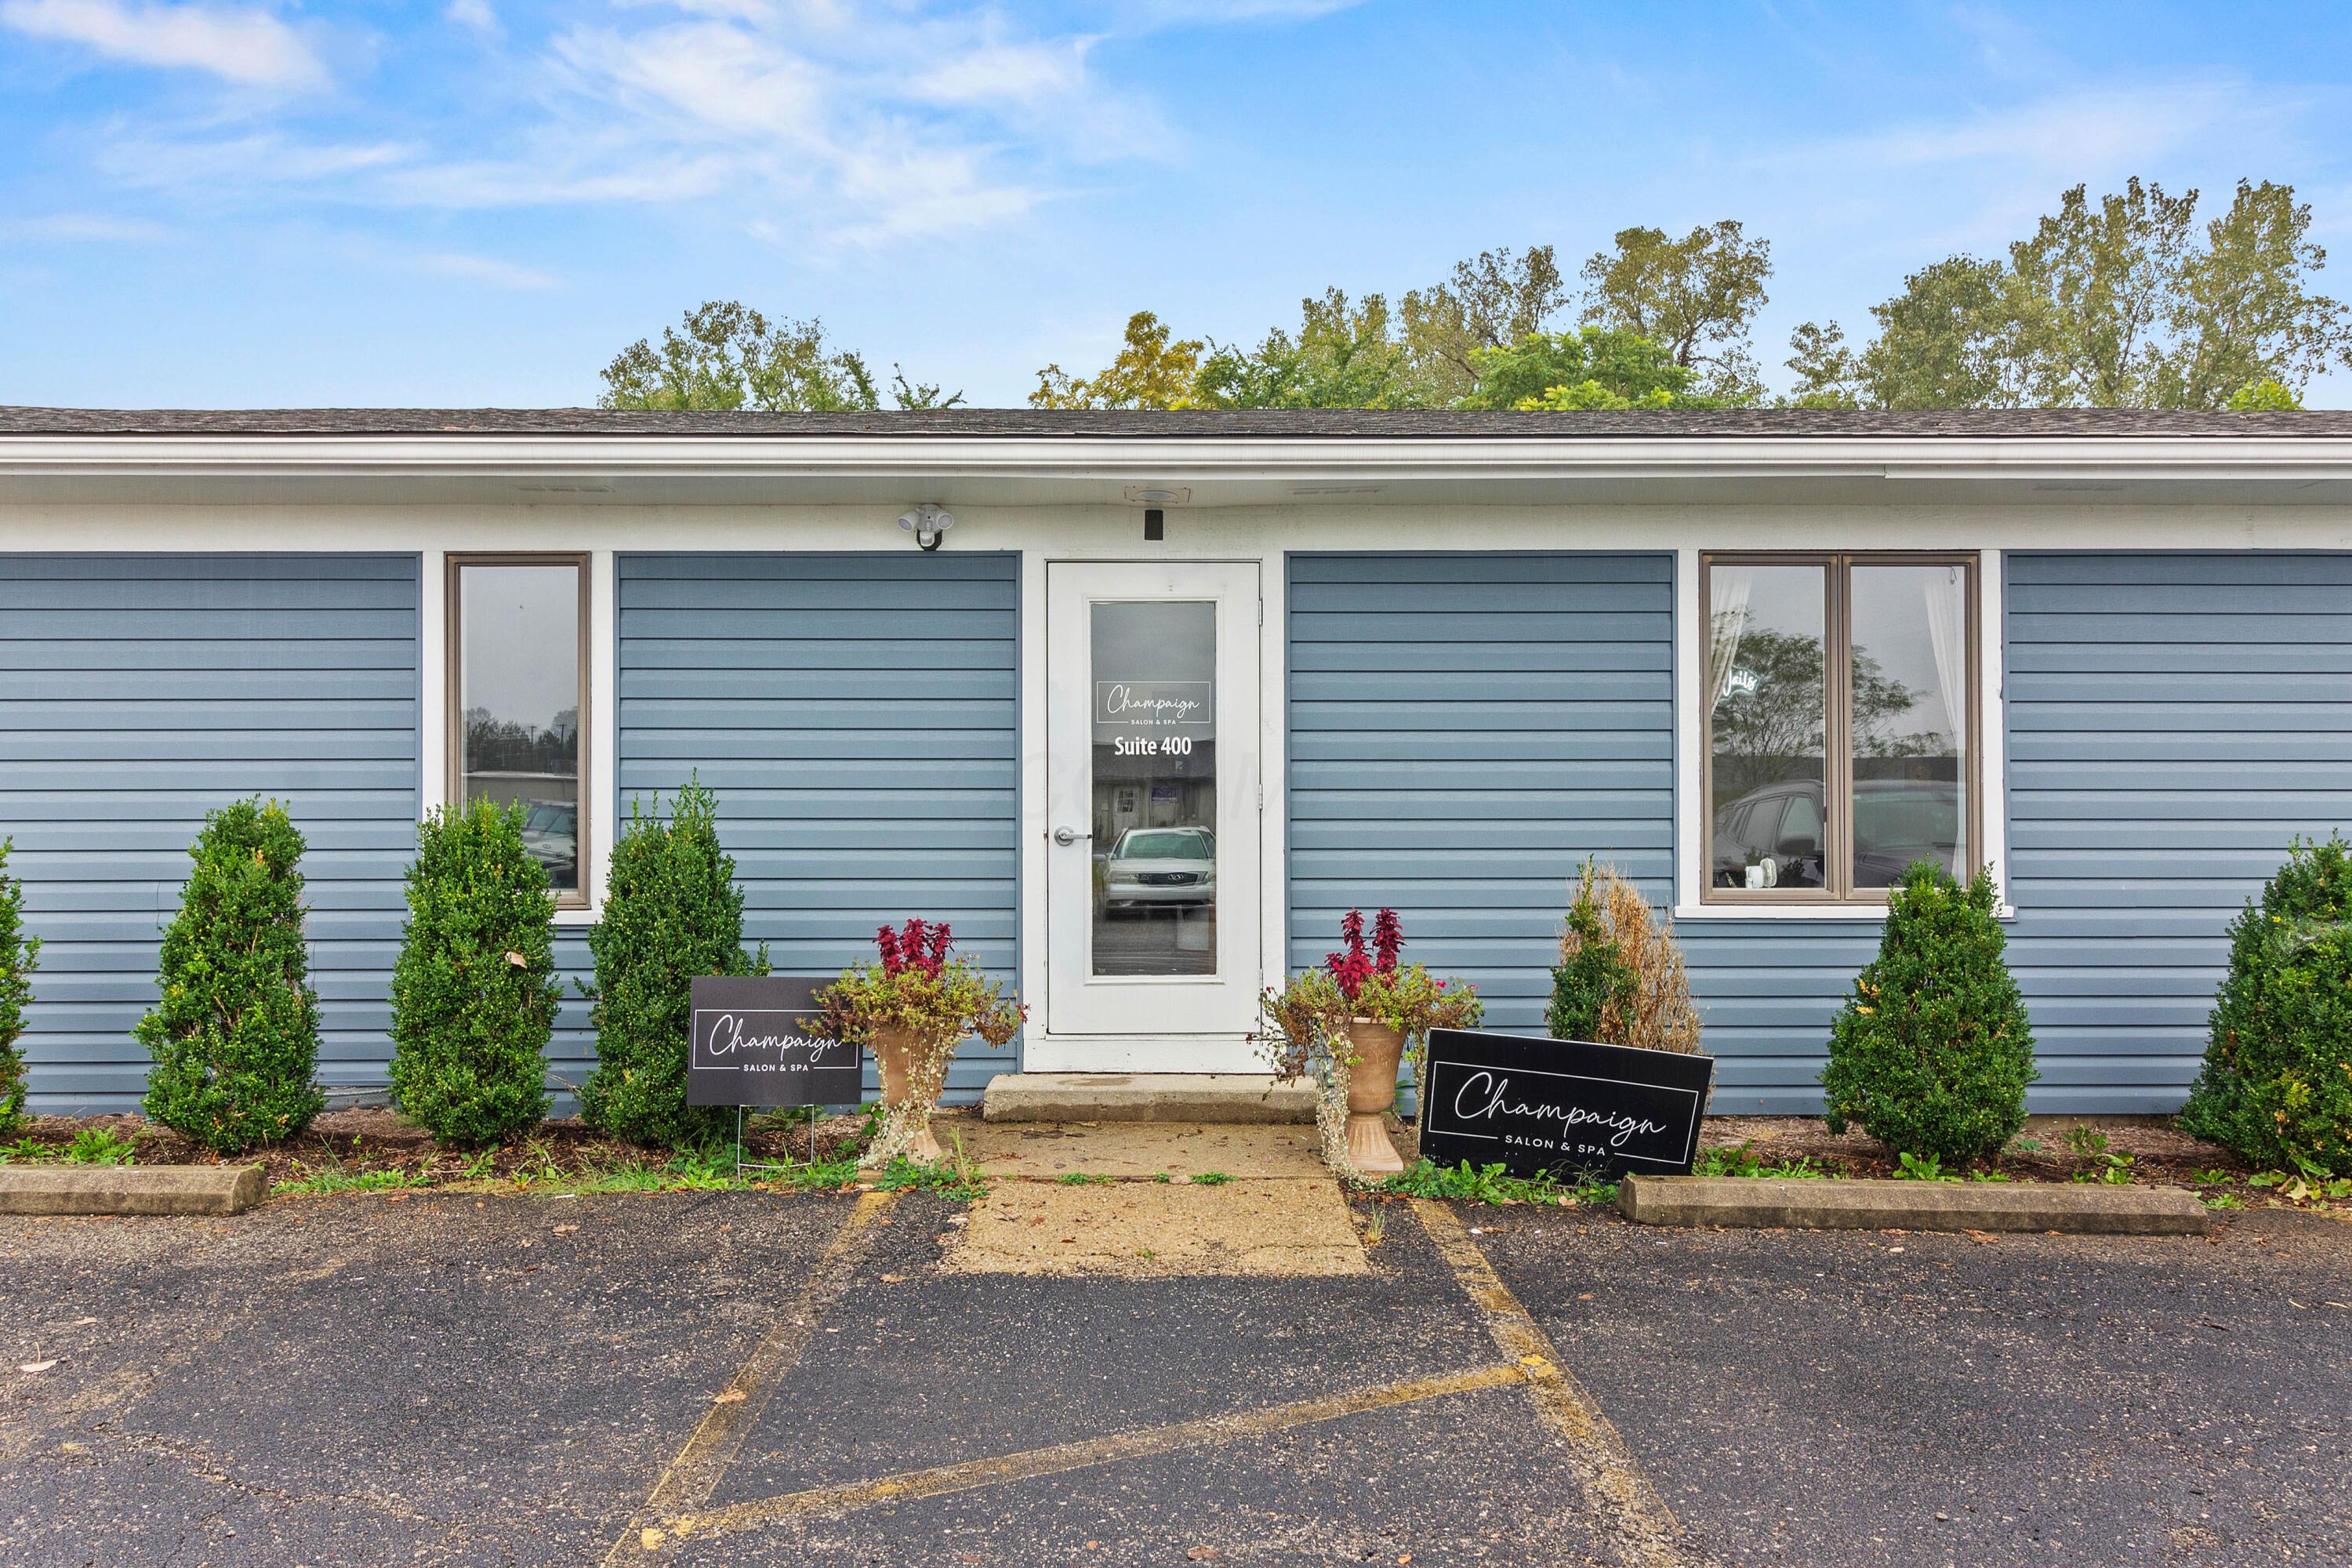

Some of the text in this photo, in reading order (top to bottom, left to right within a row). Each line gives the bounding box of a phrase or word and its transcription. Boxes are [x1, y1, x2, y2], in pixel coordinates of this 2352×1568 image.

[1107, 684, 1200, 719] Champaign
[1114, 736, 1192, 756] Suite 400
[710, 1014, 843, 1063] Champaign
[743, 1064, 775, 1073] SALON
[1455, 1072, 1667, 1147] Champaign
[1504, 1134, 1606, 1156] SALON & SPA
